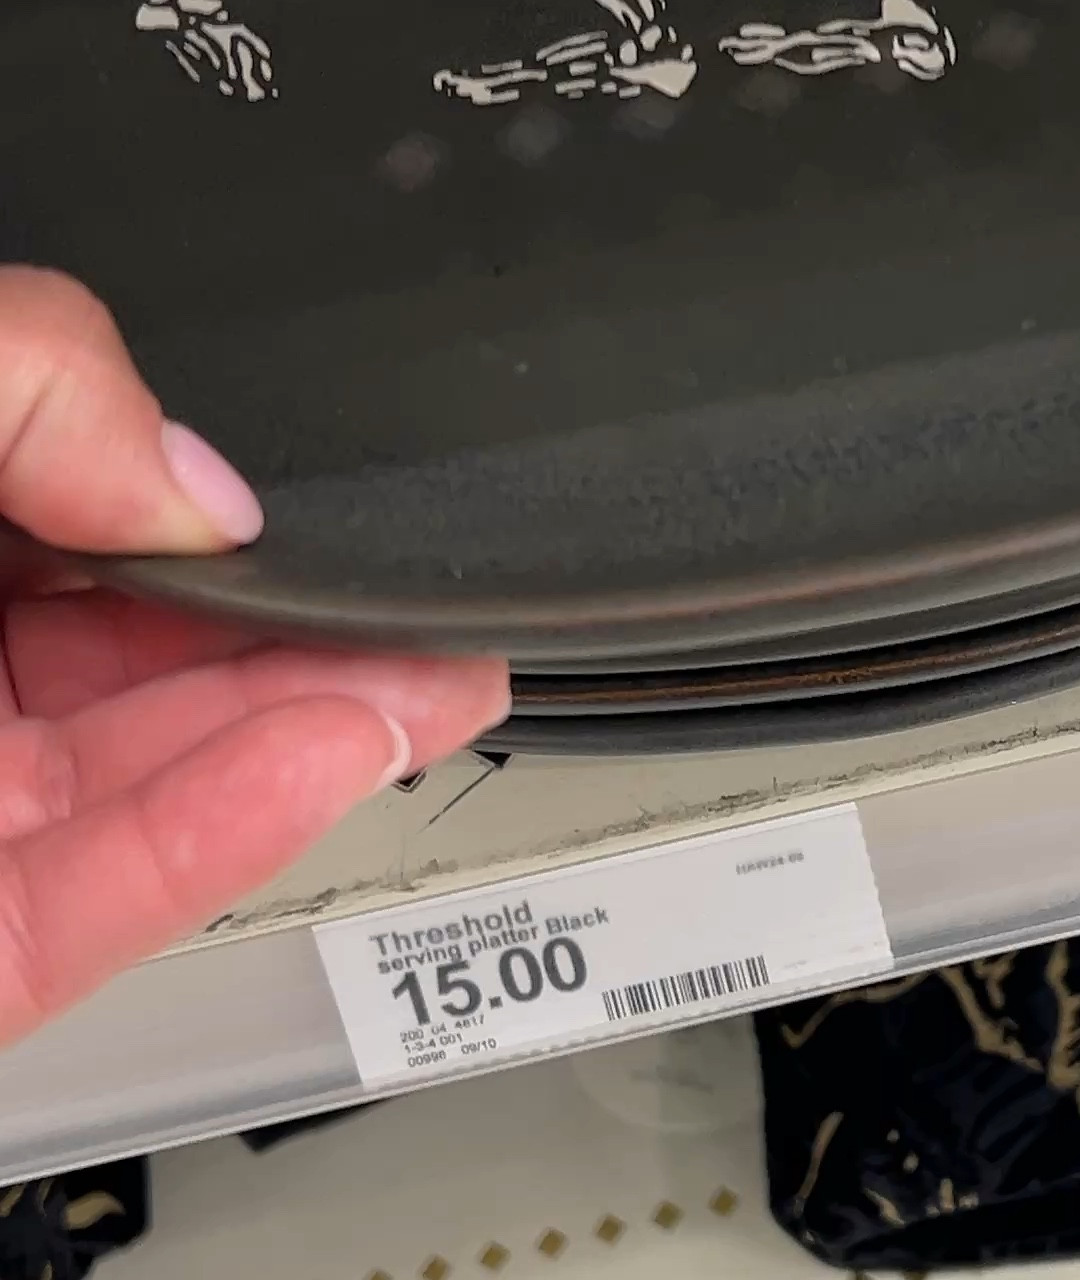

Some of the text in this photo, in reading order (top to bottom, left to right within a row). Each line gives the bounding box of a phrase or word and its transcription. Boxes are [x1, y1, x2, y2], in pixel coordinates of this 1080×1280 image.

[368, 899, 533, 957] Threshold
[377, 906, 611, 974] serving platter Black
[391, 935, 588, 1026] 15.00
[461, 1038, 497, 1055] 09/10
